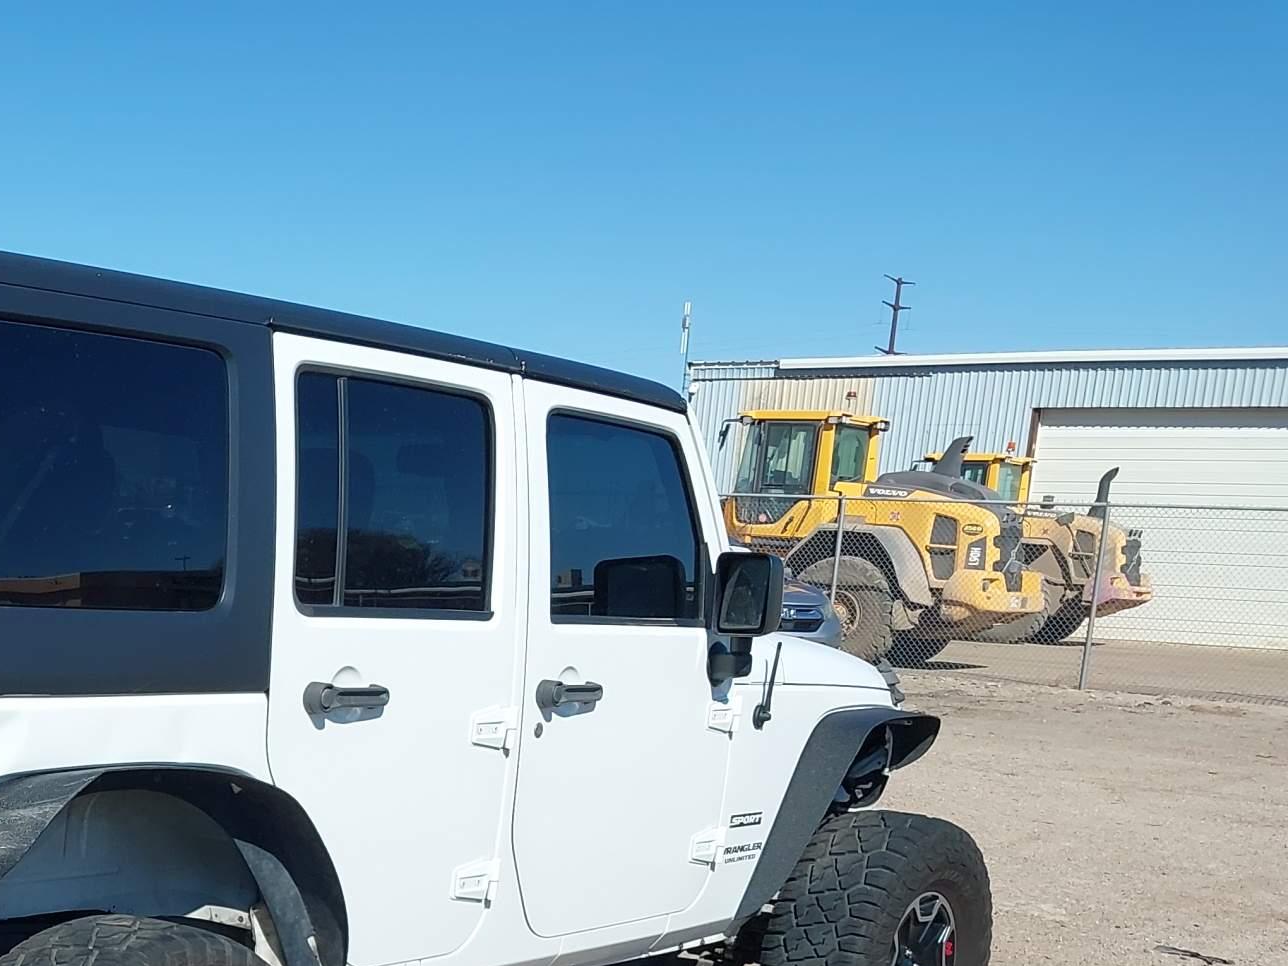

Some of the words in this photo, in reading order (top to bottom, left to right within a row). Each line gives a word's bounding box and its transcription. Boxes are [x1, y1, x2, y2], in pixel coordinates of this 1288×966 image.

[868, 487, 908, 497] VOLVO
[730, 813, 762, 827] SPORT
[724, 853, 757, 864] UNLIMITED
